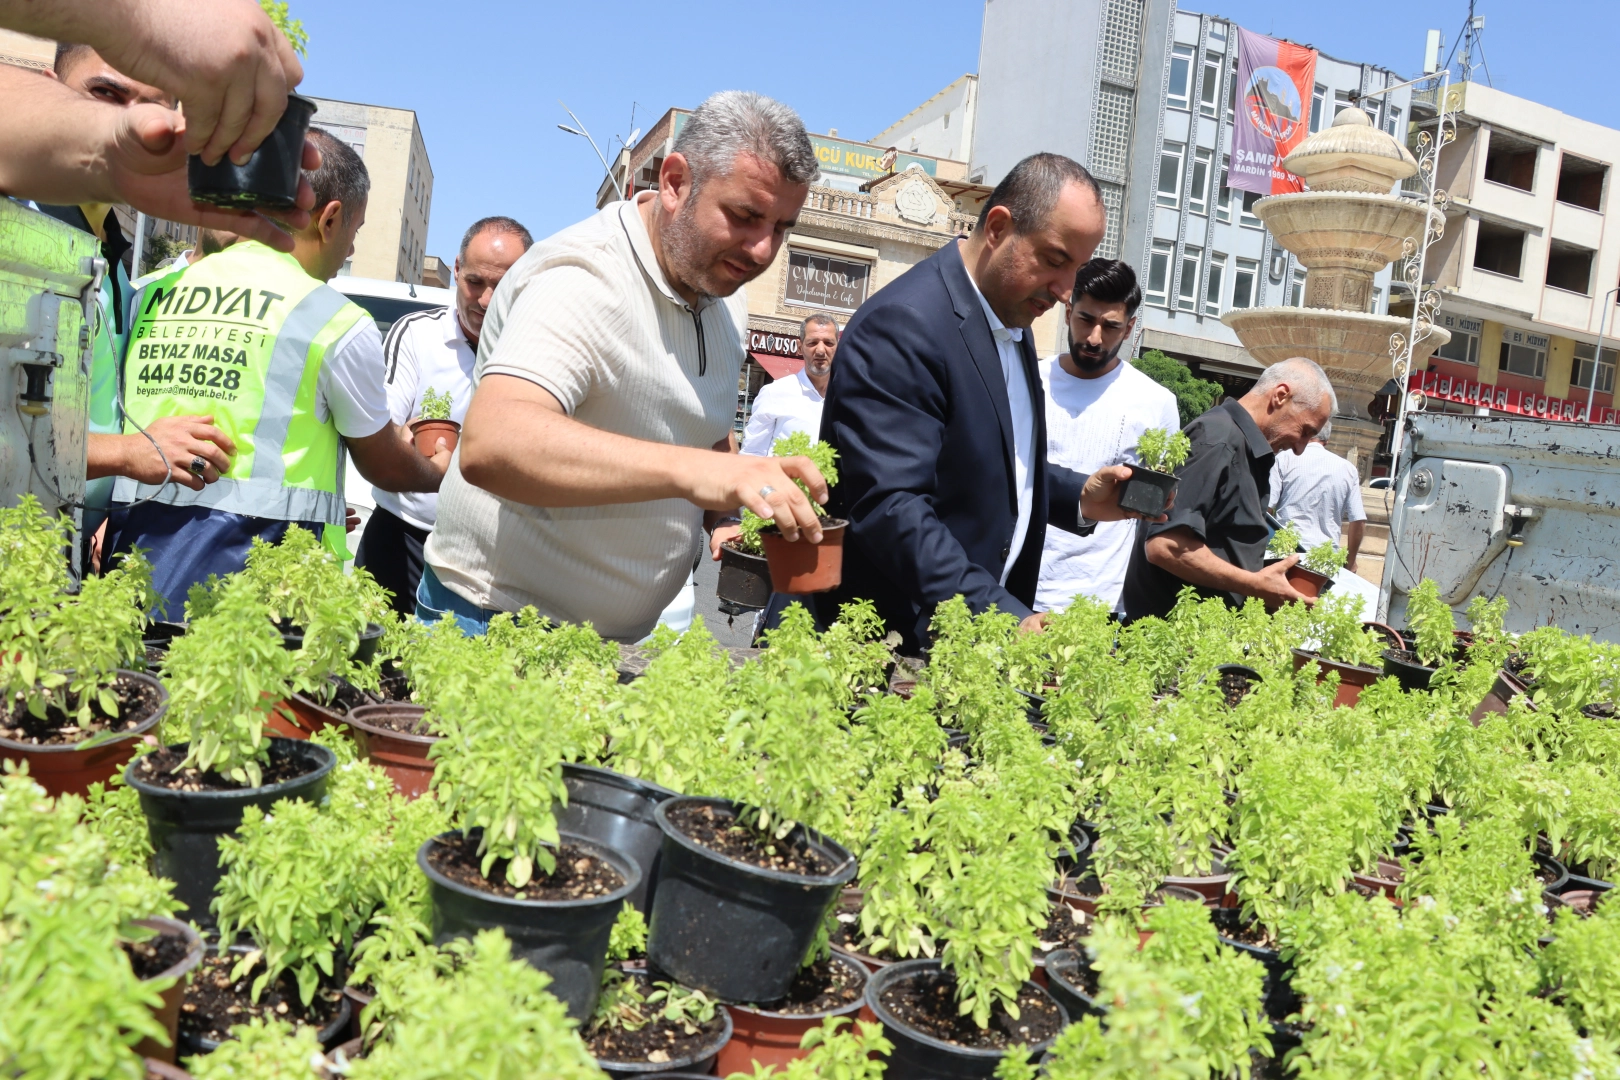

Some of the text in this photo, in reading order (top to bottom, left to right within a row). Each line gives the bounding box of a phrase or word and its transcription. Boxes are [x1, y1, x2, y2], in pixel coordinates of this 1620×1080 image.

[1233, 163, 1266, 177] MARDİN
[840, 292, 854, 305] Cafe
[1458, 318, 1481, 332] MİDYAT
[1526, 334, 1548, 348] MİDYAT
[138, 343, 248, 367] BEYAZ MASA
[138, 363, 241, 391] 444 5628
[1438, 379, 1507, 406] BAHAR
[1523, 396, 1587, 422] SOFRA
